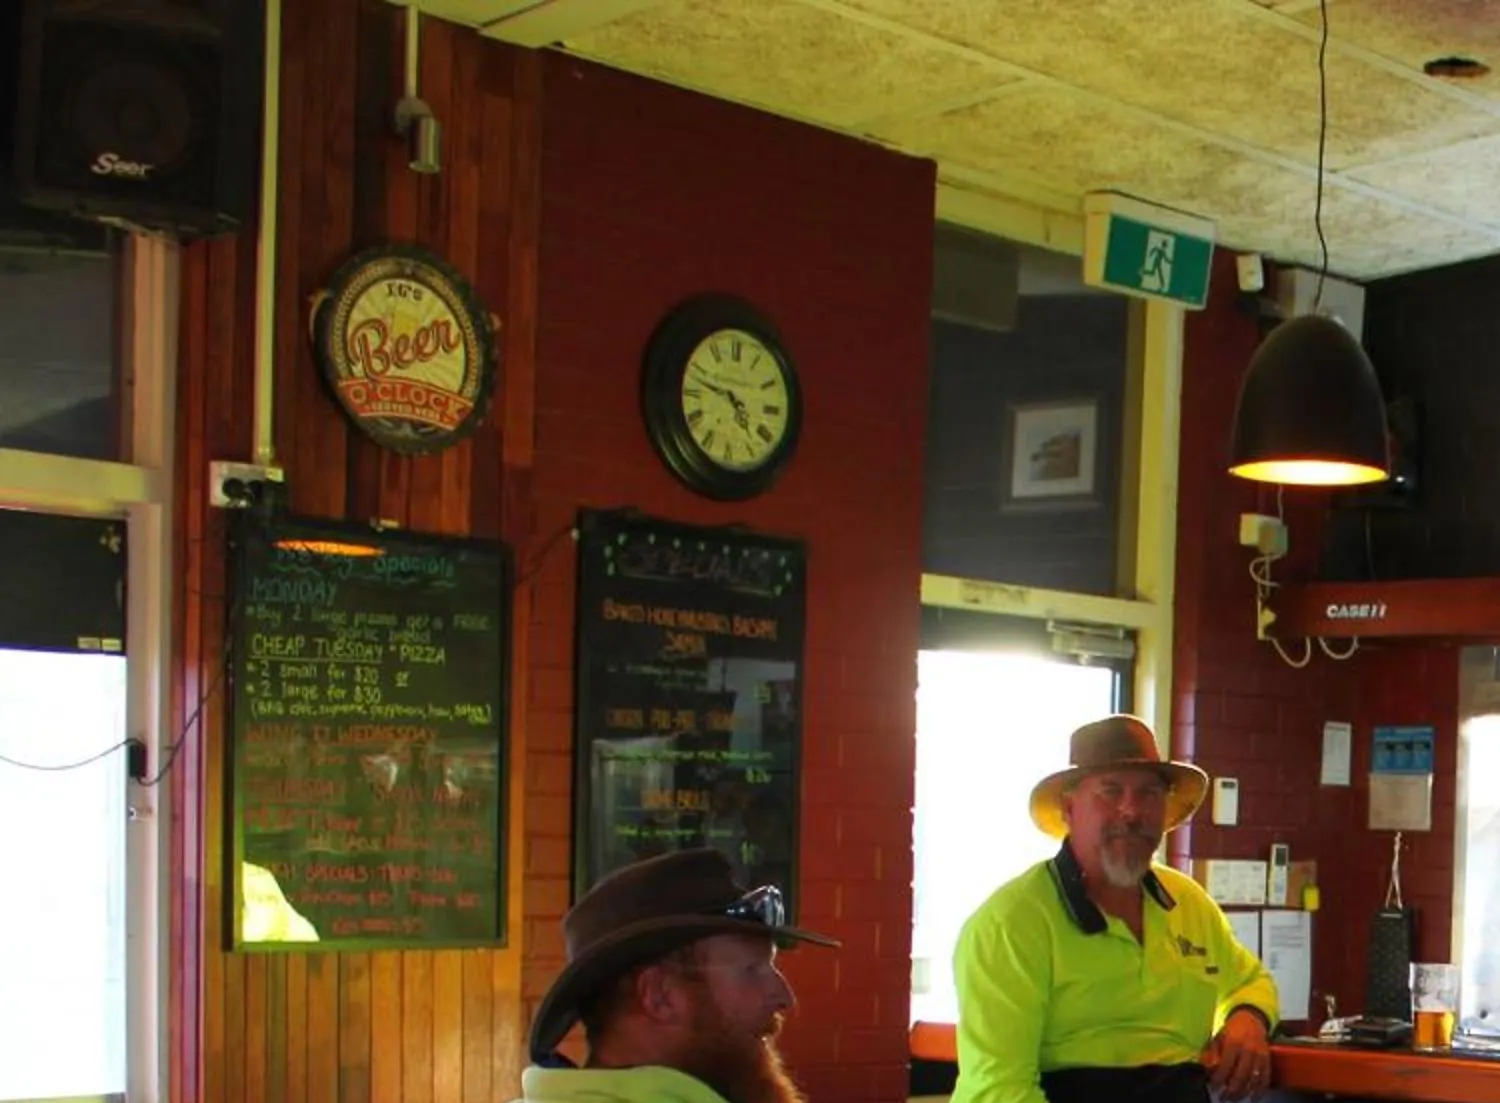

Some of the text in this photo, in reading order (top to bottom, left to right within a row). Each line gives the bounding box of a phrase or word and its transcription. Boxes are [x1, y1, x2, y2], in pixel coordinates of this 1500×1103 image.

[348, 318, 463, 379] Beer
[349, 383, 467, 422] O'CLOCK
[252, 576, 339, 606] MONDAY
[251, 633, 306, 658] CHEAP
[314, 637, 384, 660] TUESDAY
